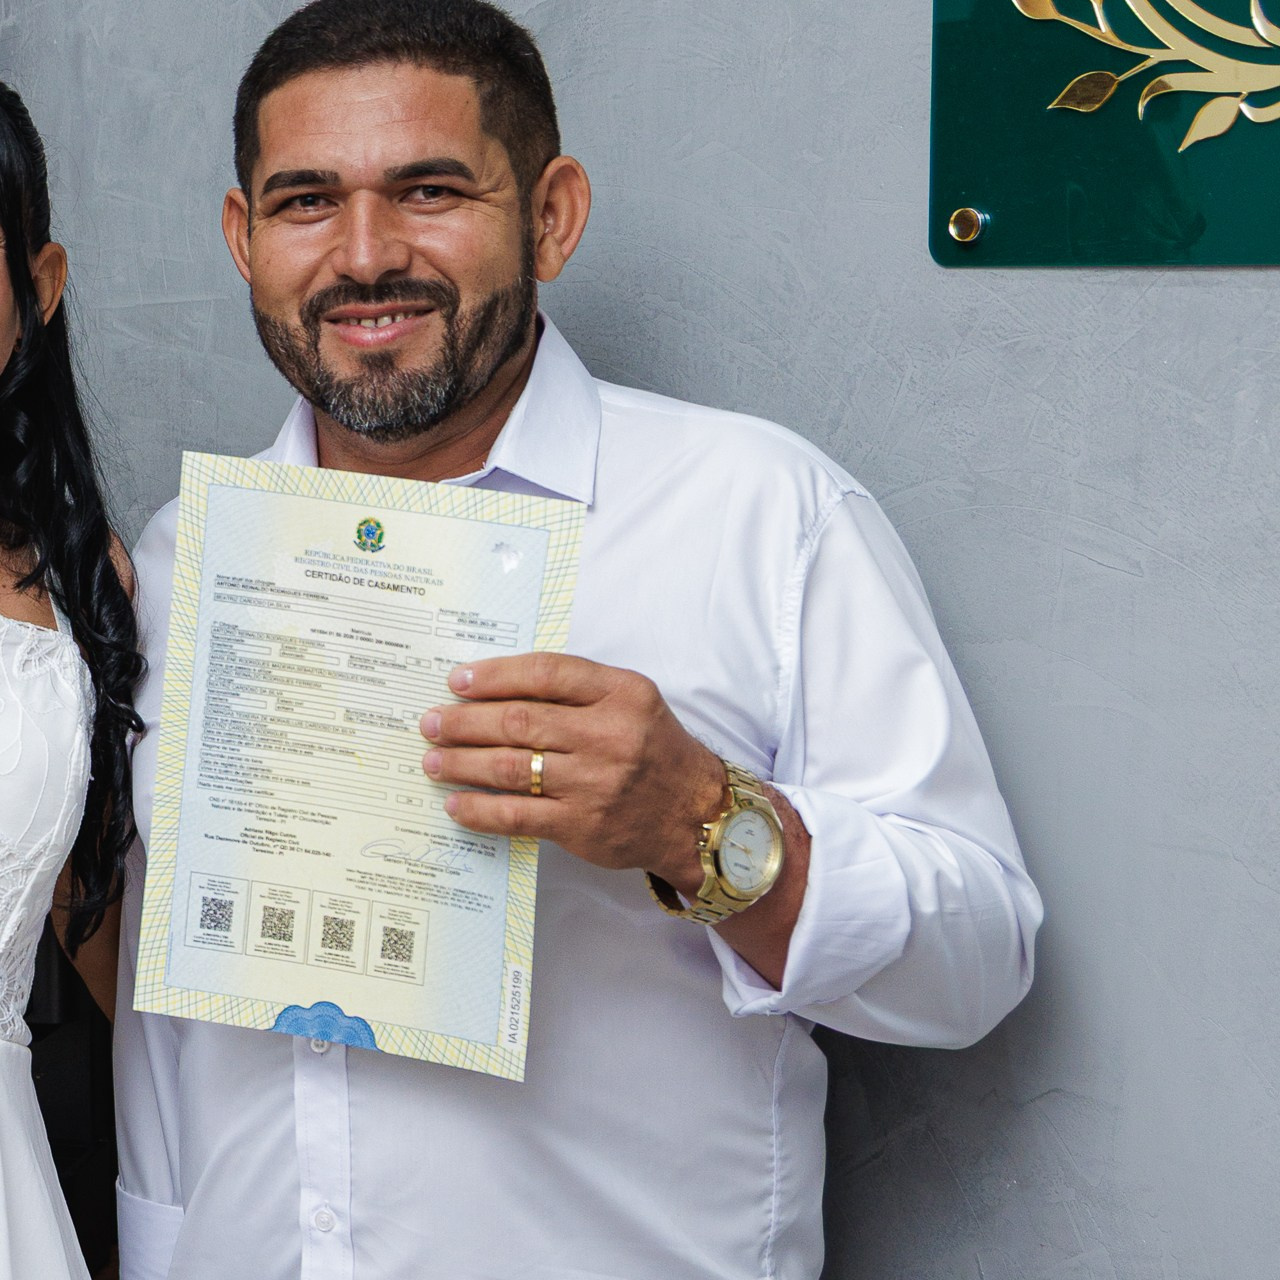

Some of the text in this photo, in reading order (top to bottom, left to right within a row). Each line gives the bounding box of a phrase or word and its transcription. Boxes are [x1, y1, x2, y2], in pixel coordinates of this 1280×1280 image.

[294, 556, 444, 586] REGISTRO CIVIL DAS PESSOAS NATURAIS
[304, 548, 433, 576] REPÚBLICA FEDERATIVA DO BRASIL
[304, 568, 425, 595] CERTIDÃO DE CASAMENTO
[509, 970, 523, 1031] 021525199
